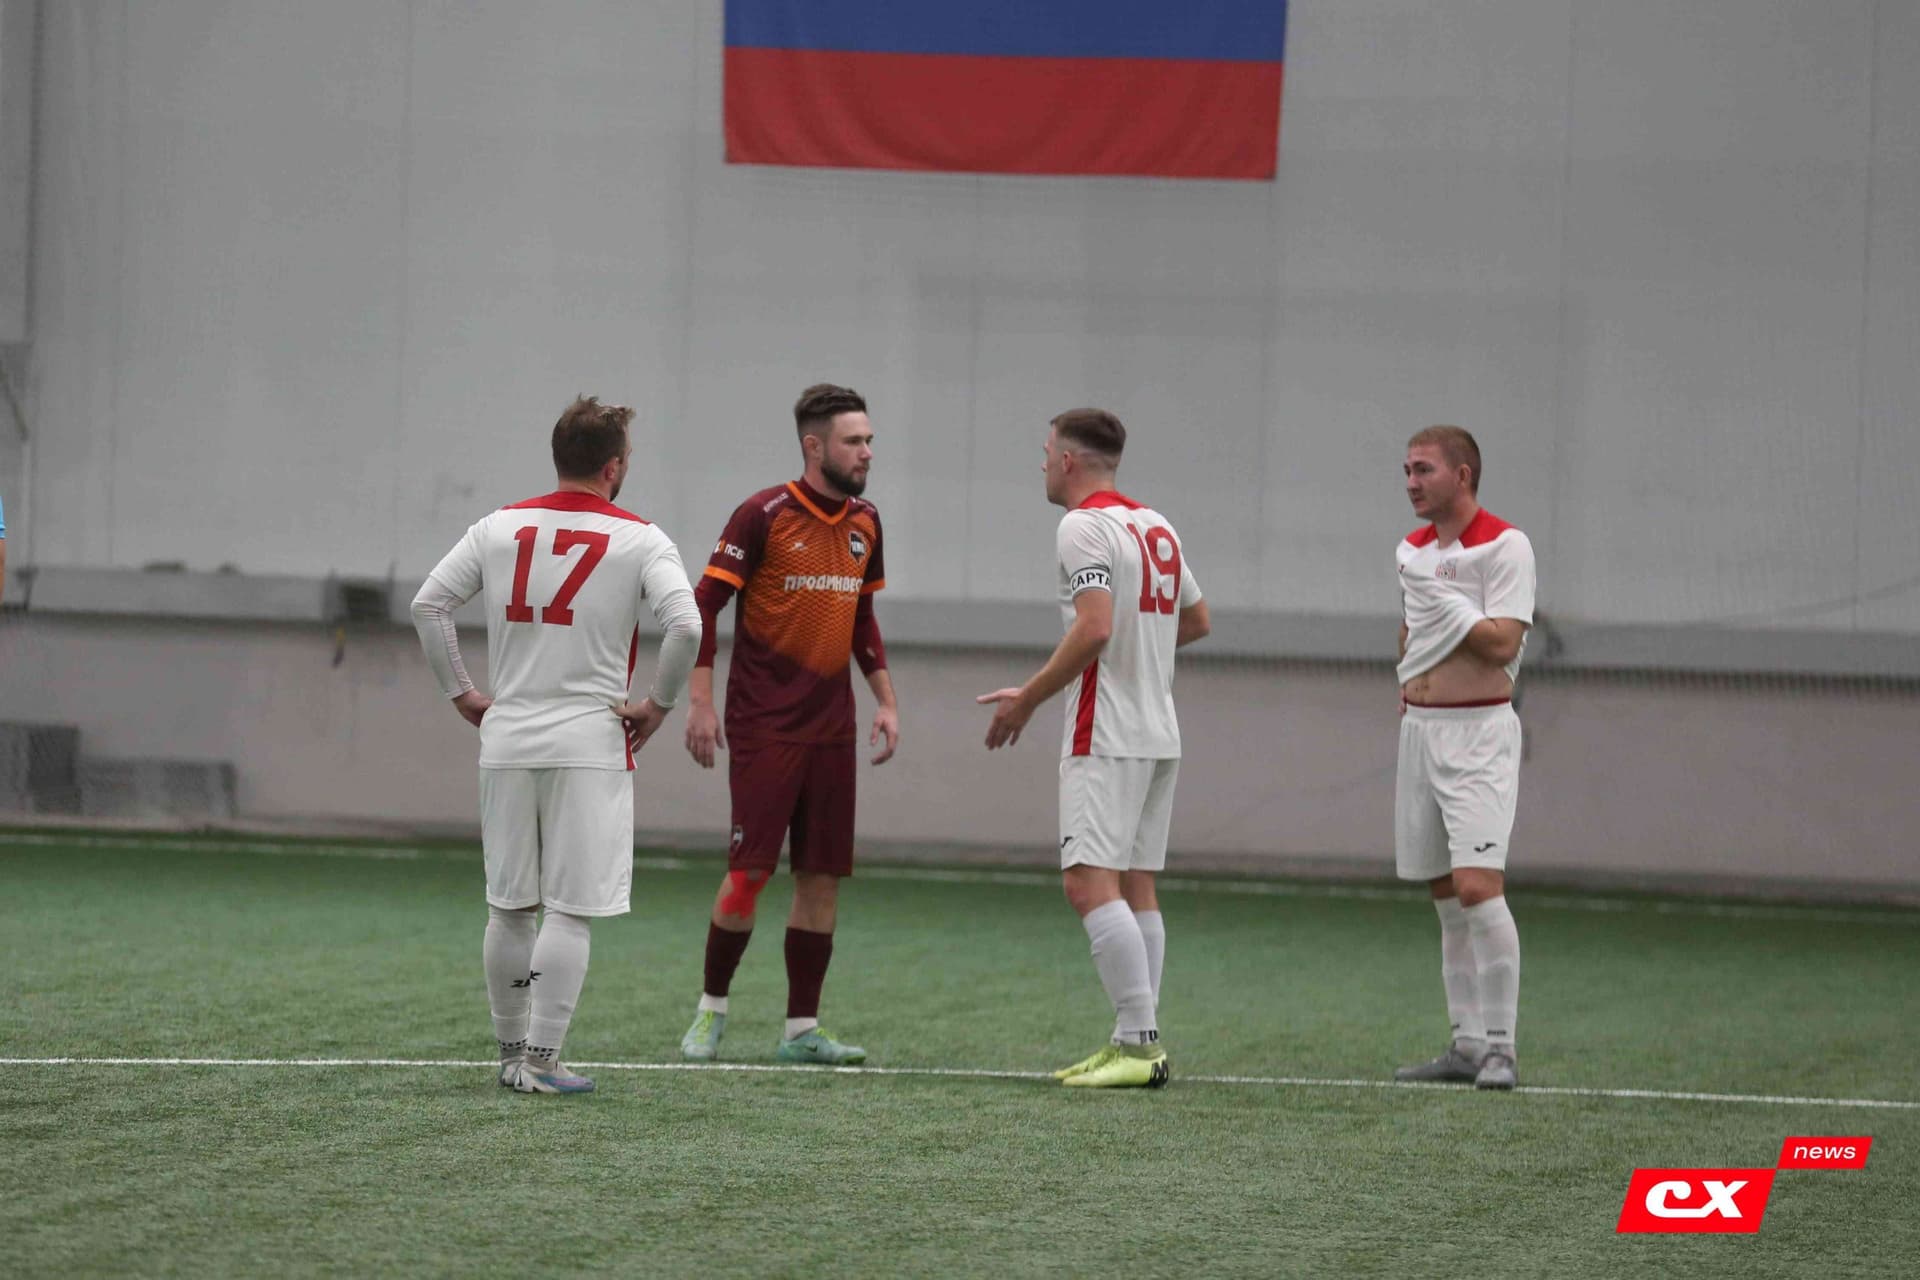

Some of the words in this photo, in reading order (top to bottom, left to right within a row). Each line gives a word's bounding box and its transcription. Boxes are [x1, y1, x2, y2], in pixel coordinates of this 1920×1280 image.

[506, 526, 610, 626] 17
[724, 543, 745, 560] ПСБ
[1126, 523, 1181, 615] 19
